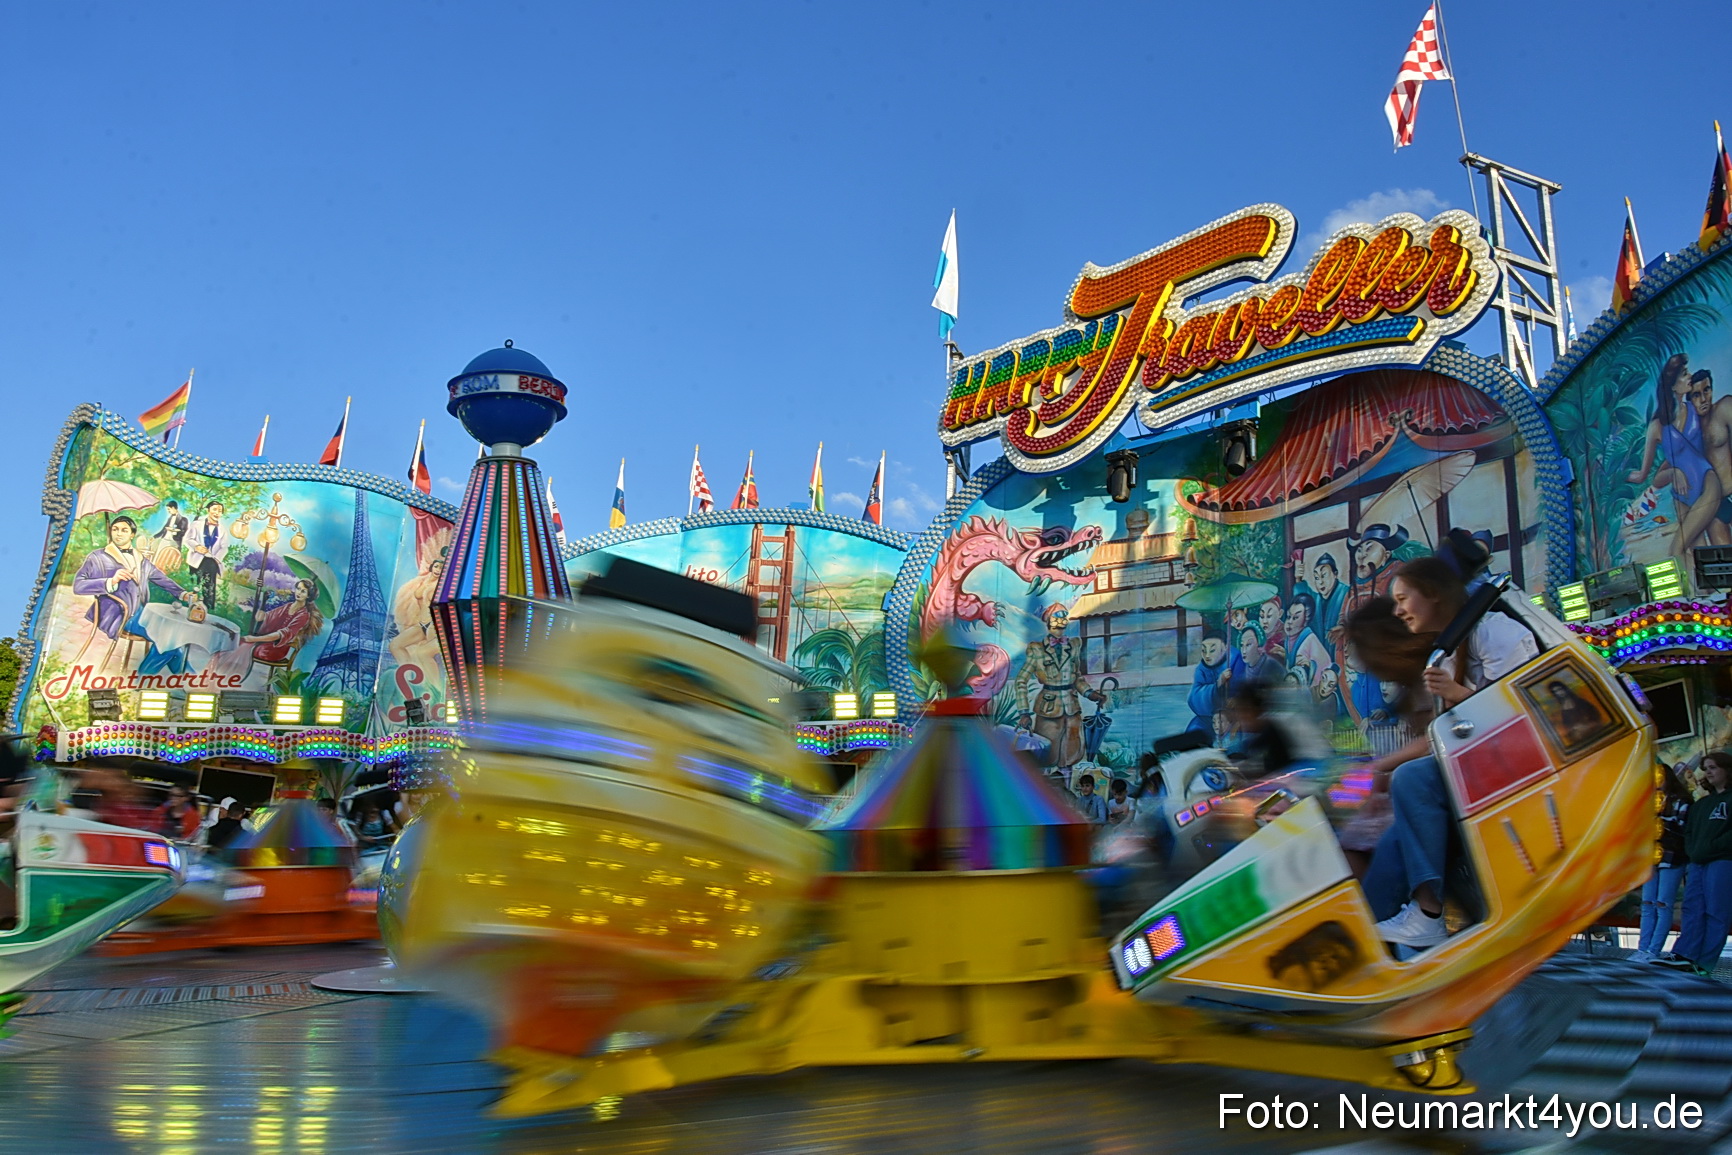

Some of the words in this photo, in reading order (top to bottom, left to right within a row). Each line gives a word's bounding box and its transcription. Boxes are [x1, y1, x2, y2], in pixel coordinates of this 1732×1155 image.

[1007, 214, 1477, 455] Traveller
[462, 374, 500, 394] ROM
[44, 664, 242, 700] Montmartre
